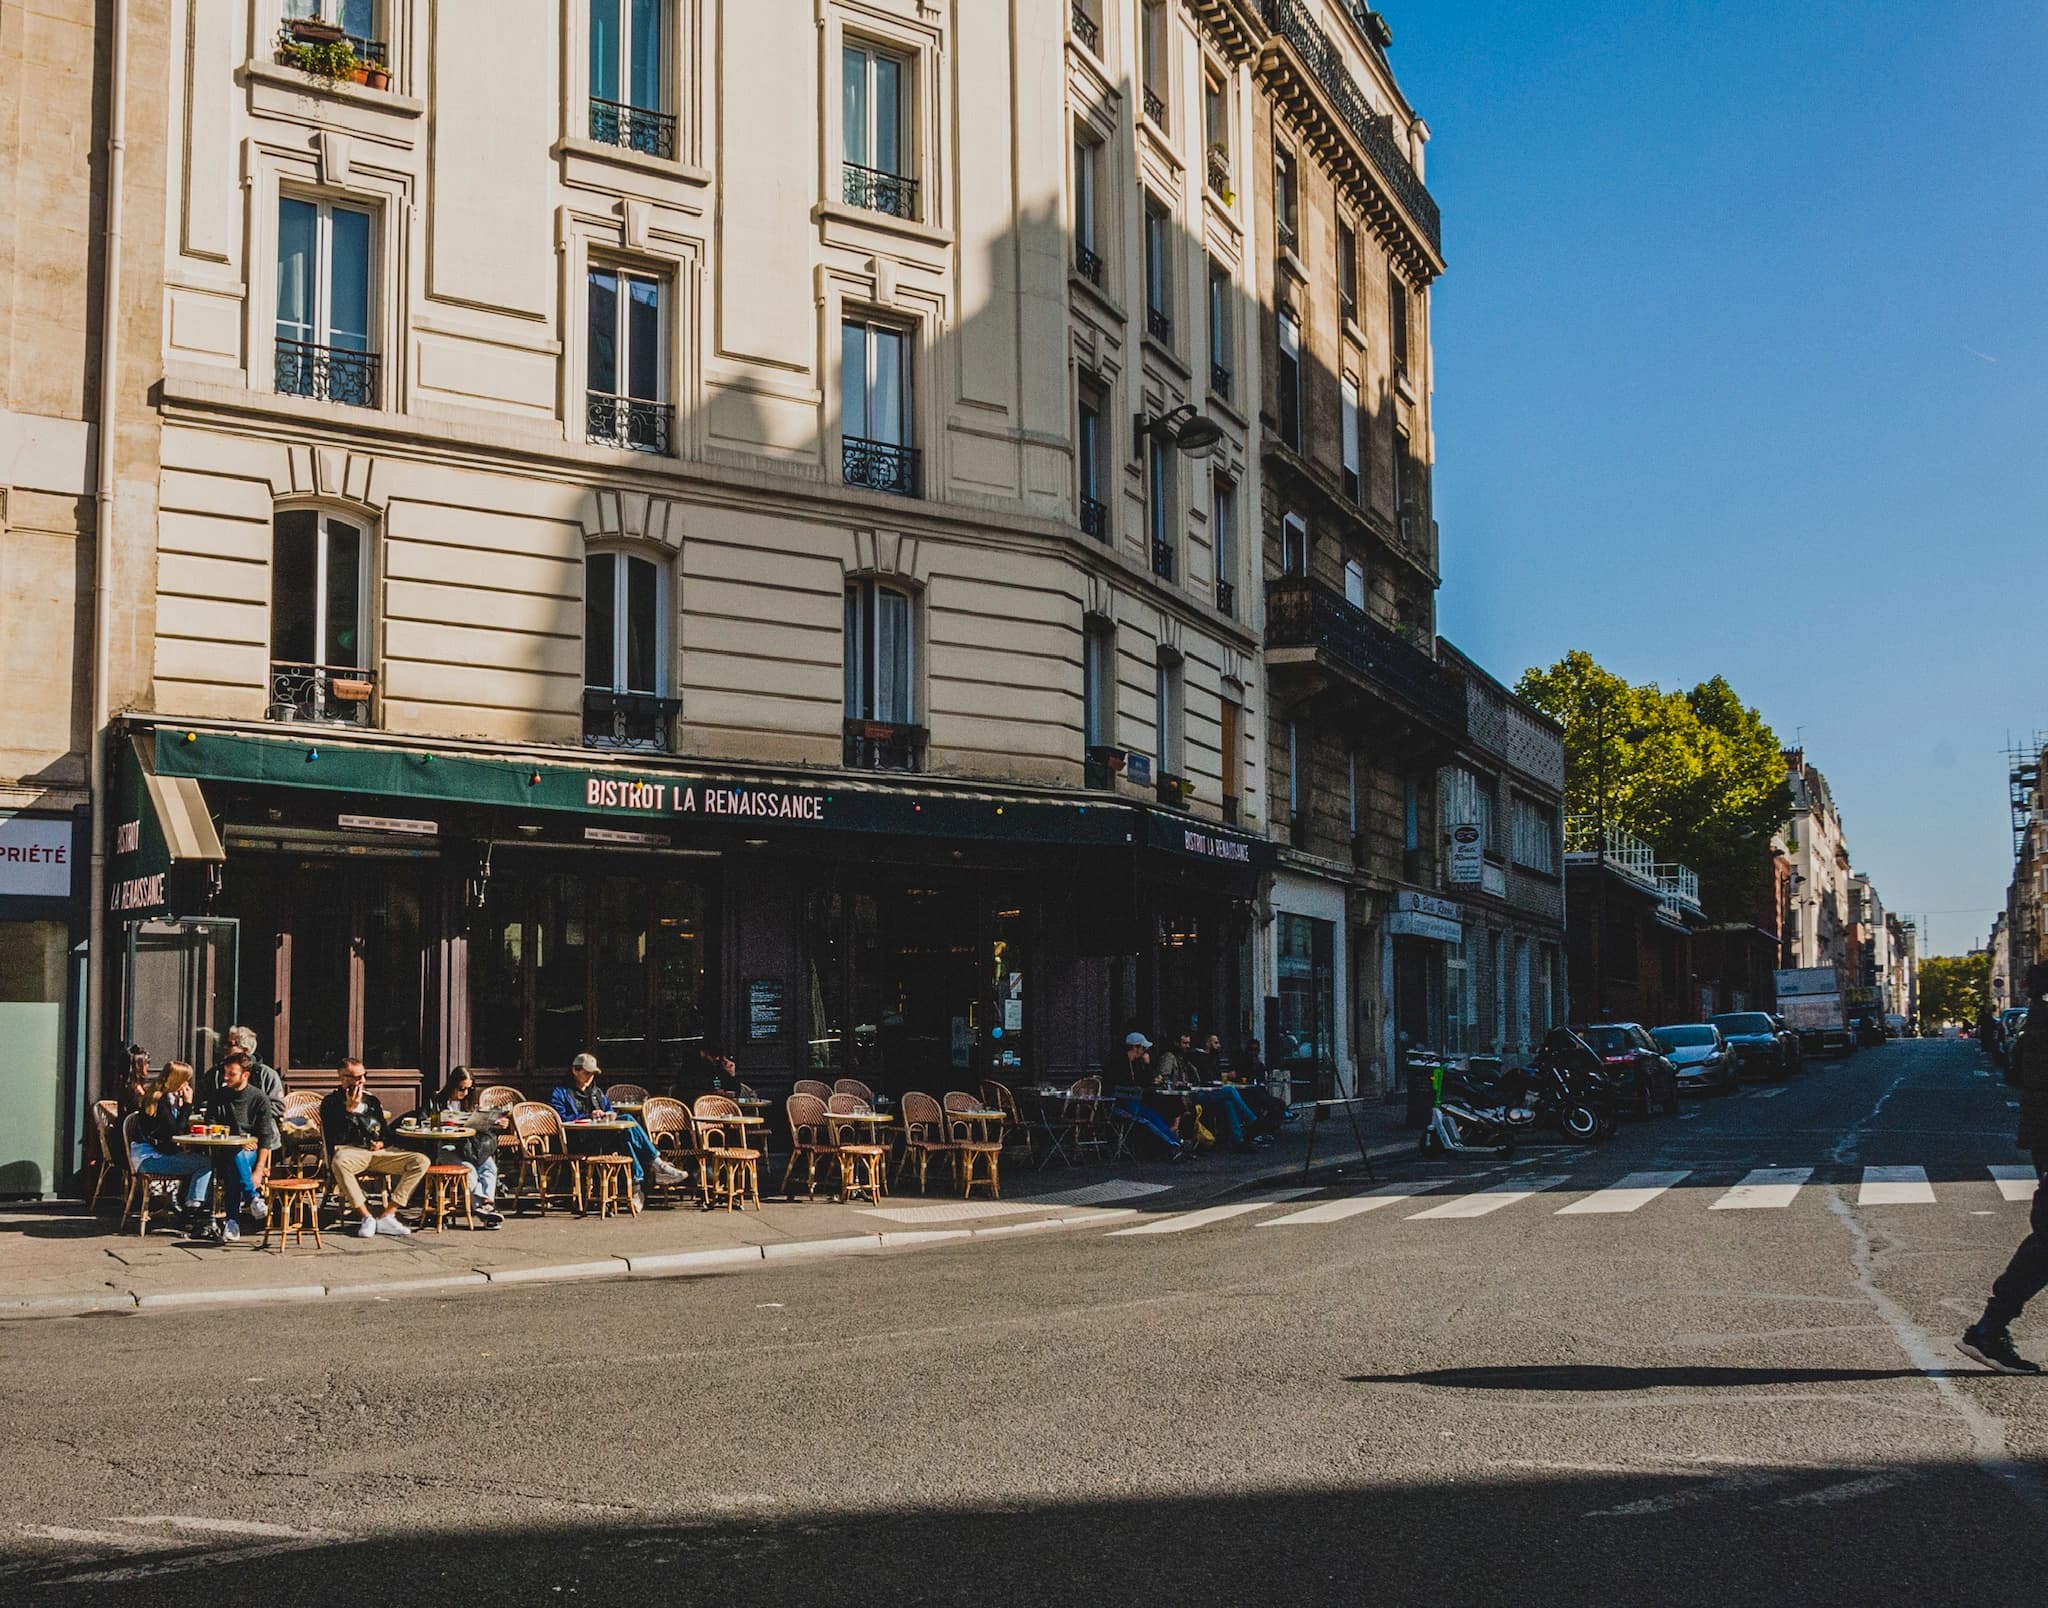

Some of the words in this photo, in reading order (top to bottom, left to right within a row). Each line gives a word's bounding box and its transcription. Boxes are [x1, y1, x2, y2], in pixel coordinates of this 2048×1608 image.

[587, 779, 665, 810] BISTROT
[673, 786, 696, 812] LA
[705, 788, 823, 820] RENAISSANCE
[117, 820, 140, 854] BISTROT
[1184, 830, 1206, 854] BISTROT
[1207, 837, 1215, 856] LA
[1216, 839, 1250, 862] RENAISSANCE
[111, 883, 120, 910] LA
[121, 872, 165, 909] RENAISSANCE
